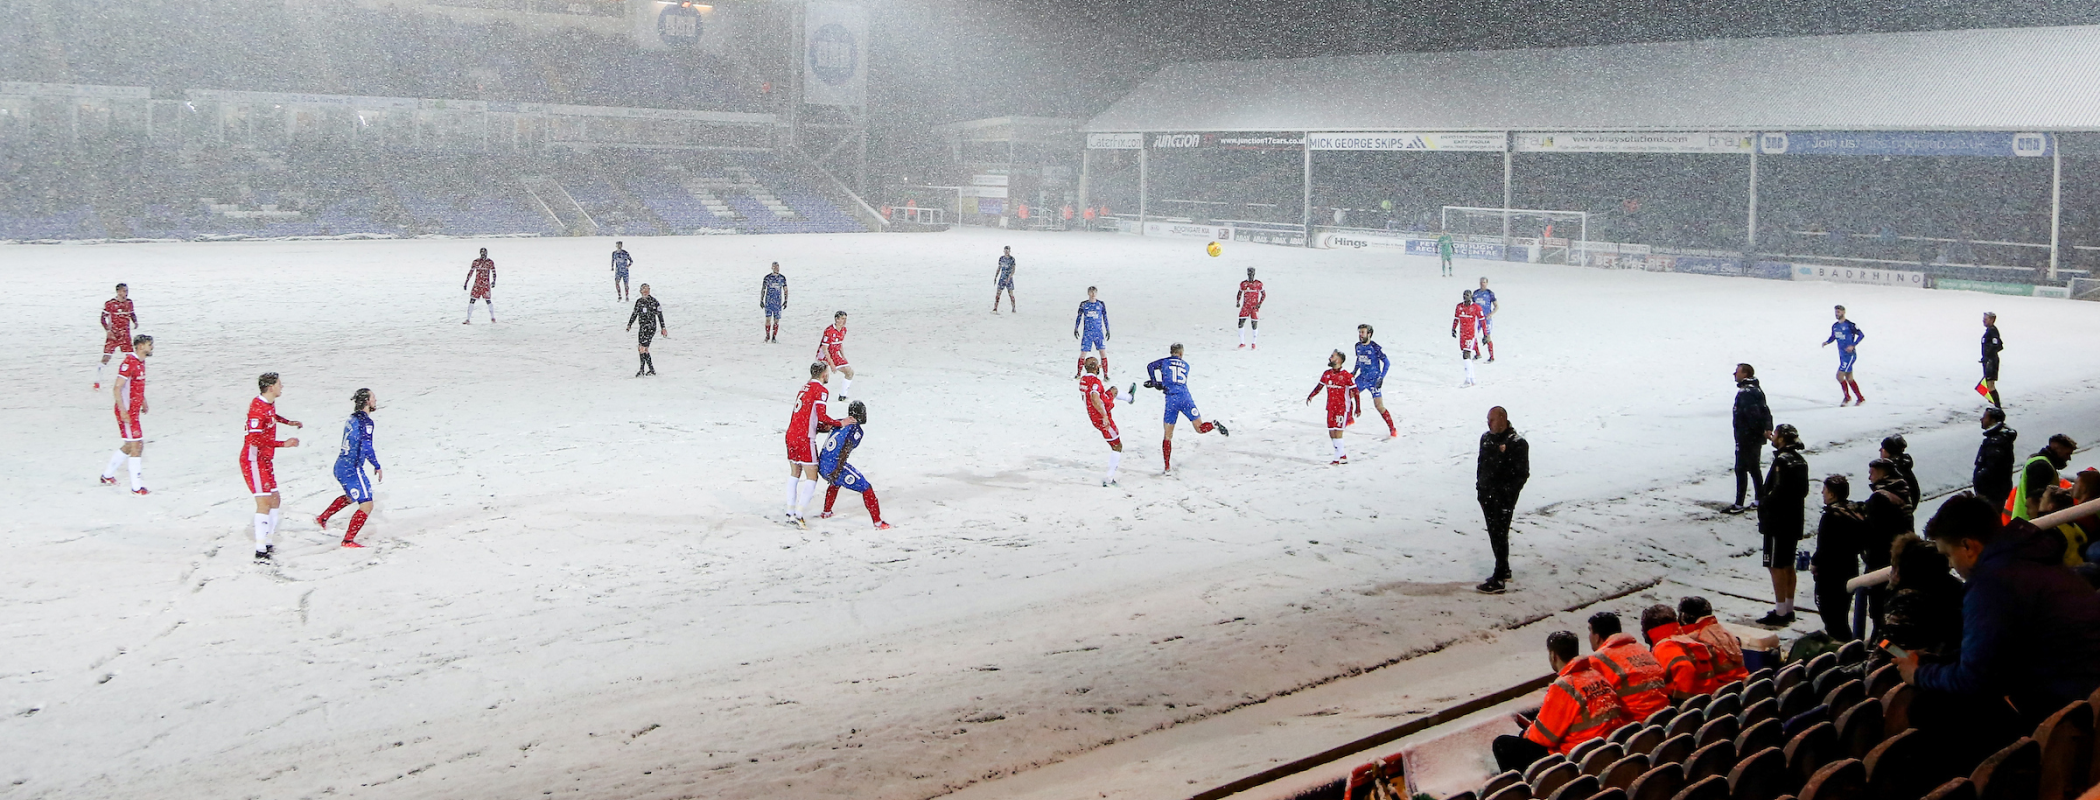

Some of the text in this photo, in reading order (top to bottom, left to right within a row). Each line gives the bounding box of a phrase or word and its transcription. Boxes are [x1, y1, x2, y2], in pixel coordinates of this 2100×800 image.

[1309, 138, 1404, 149] MICK GEORGE SKIPS
[1811, 139, 1837, 149] Join
[1334, 237, 1368, 249] Hings
[1818, 268, 1921, 284] BADRHINO
[1168, 365, 1188, 384] 15
[794, 392, 805, 413] 6
